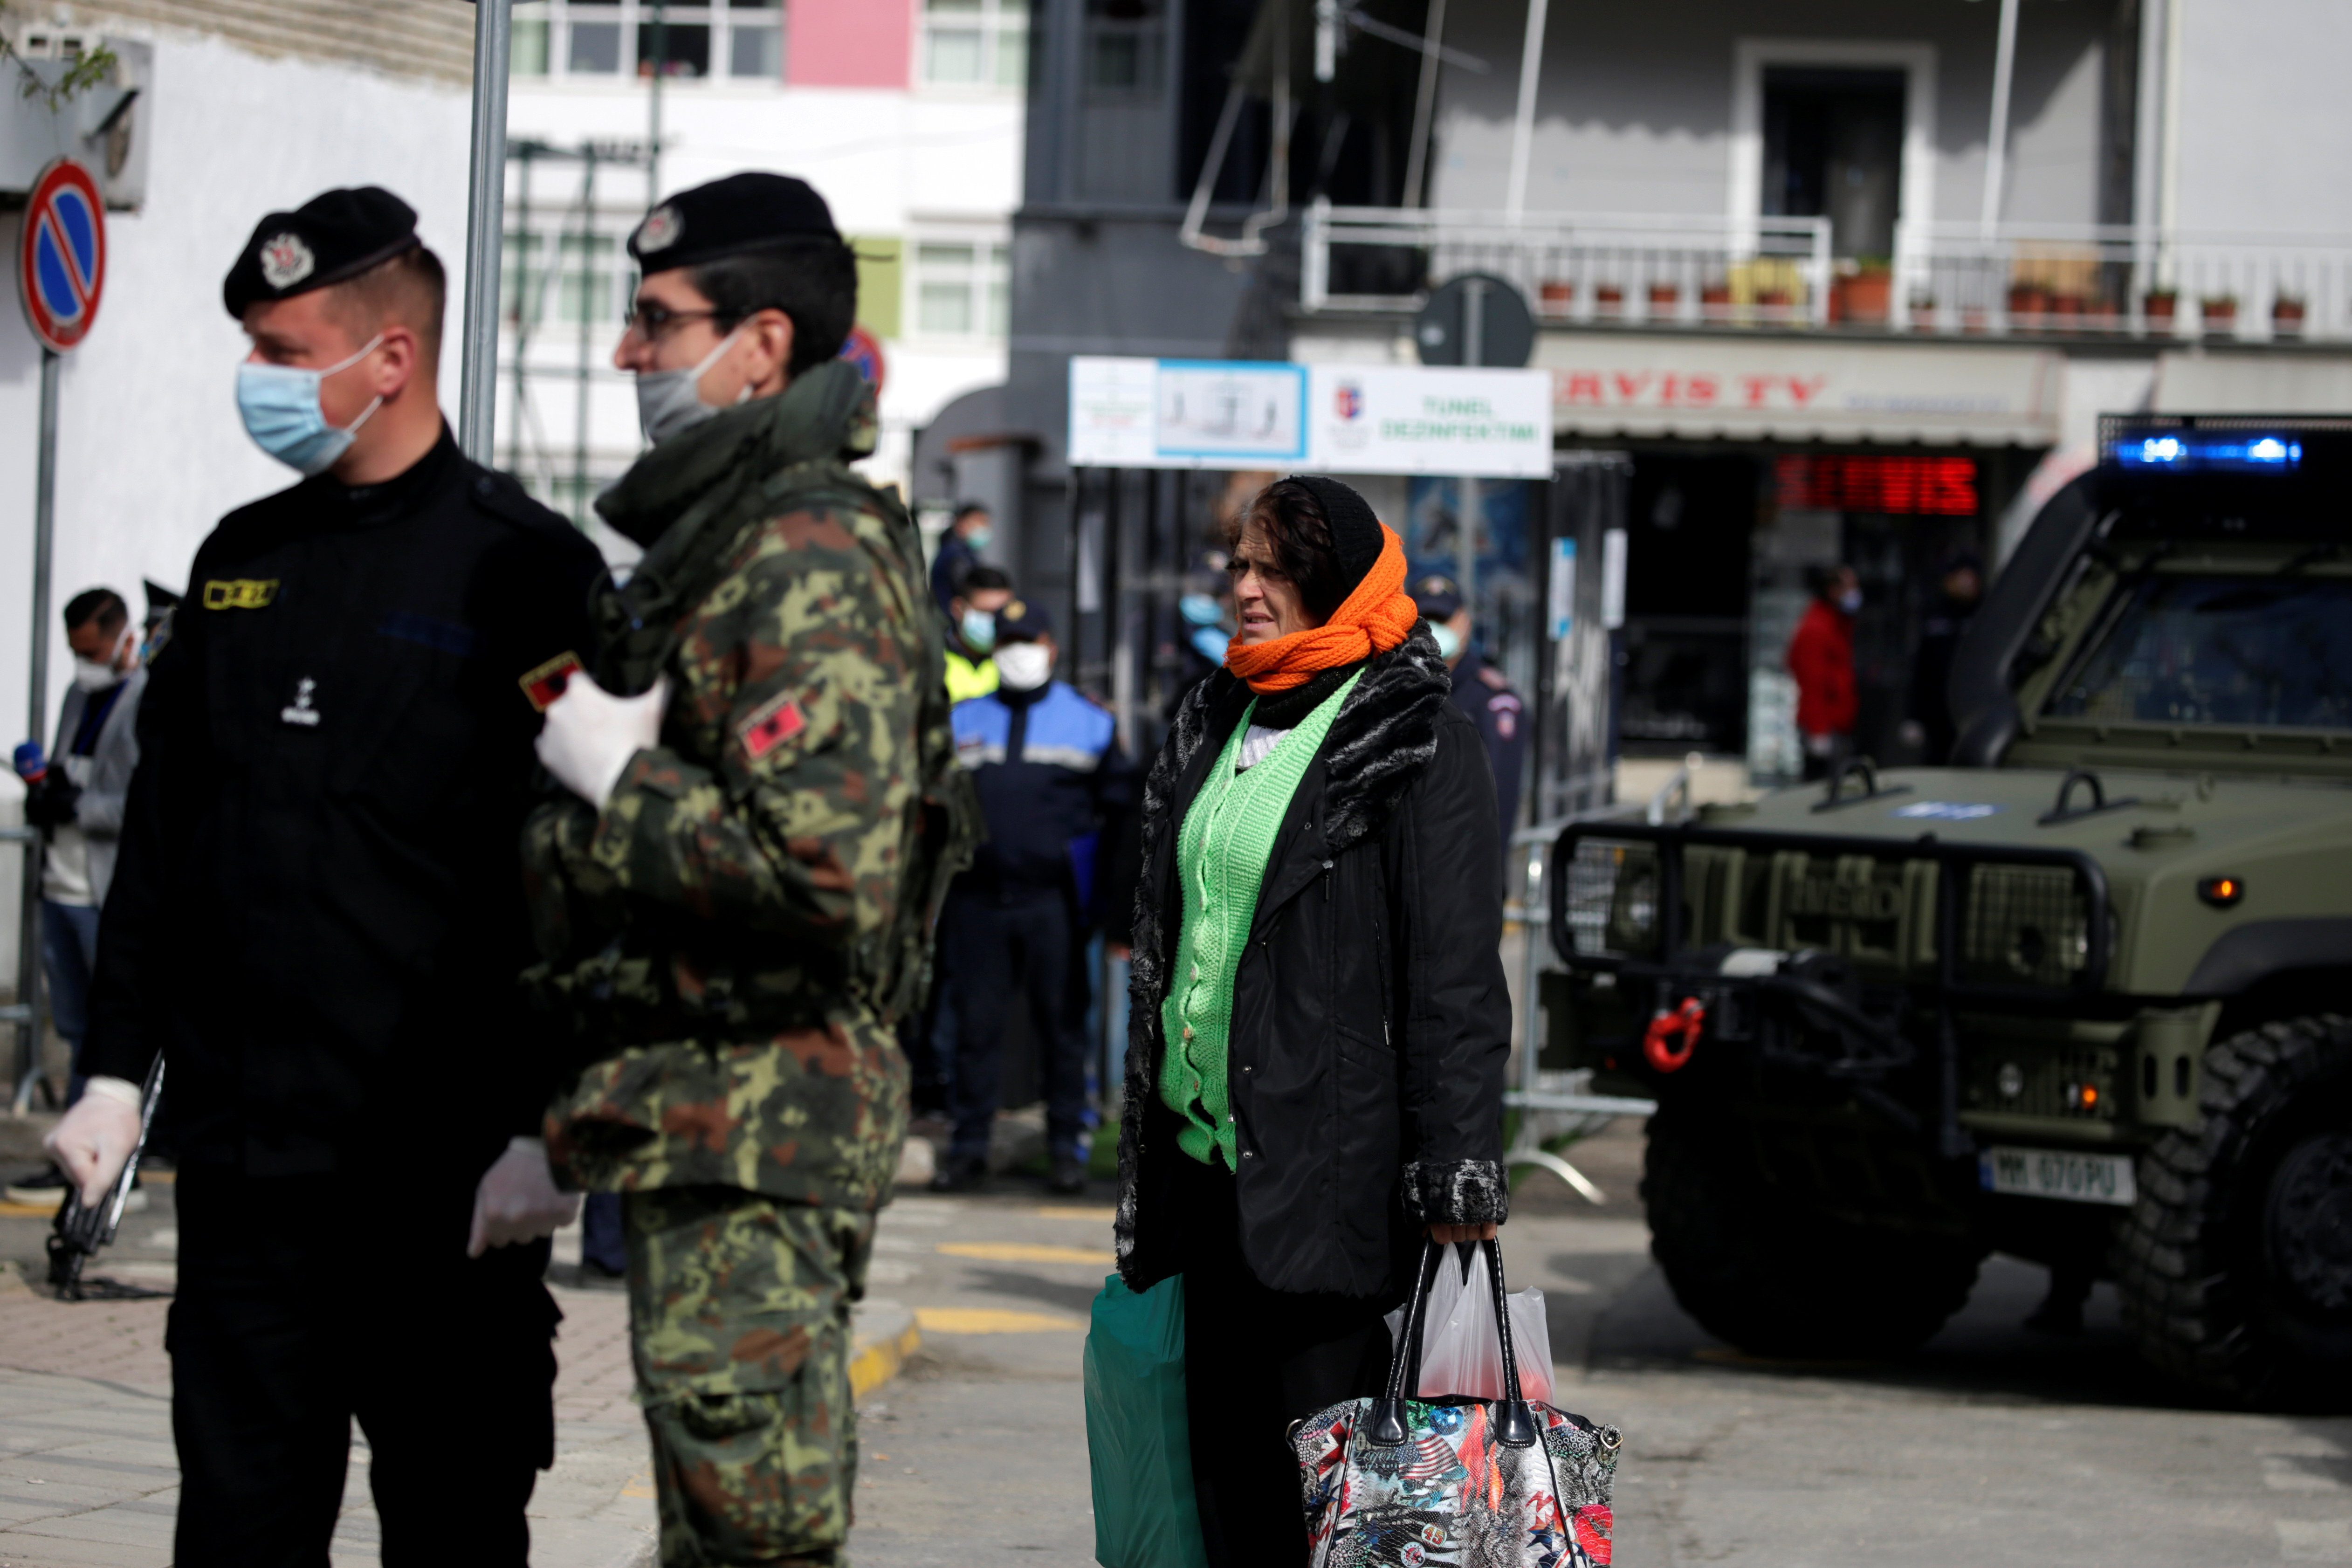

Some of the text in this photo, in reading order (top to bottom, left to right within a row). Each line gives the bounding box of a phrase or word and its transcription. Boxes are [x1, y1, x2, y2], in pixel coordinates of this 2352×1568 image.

[1736, 371, 1827, 410] TV
[1422, 395, 1493, 417] TUNEL
[1790, 876, 1903, 920] IVECO
[1423, 1527, 1445, 1545] 45
